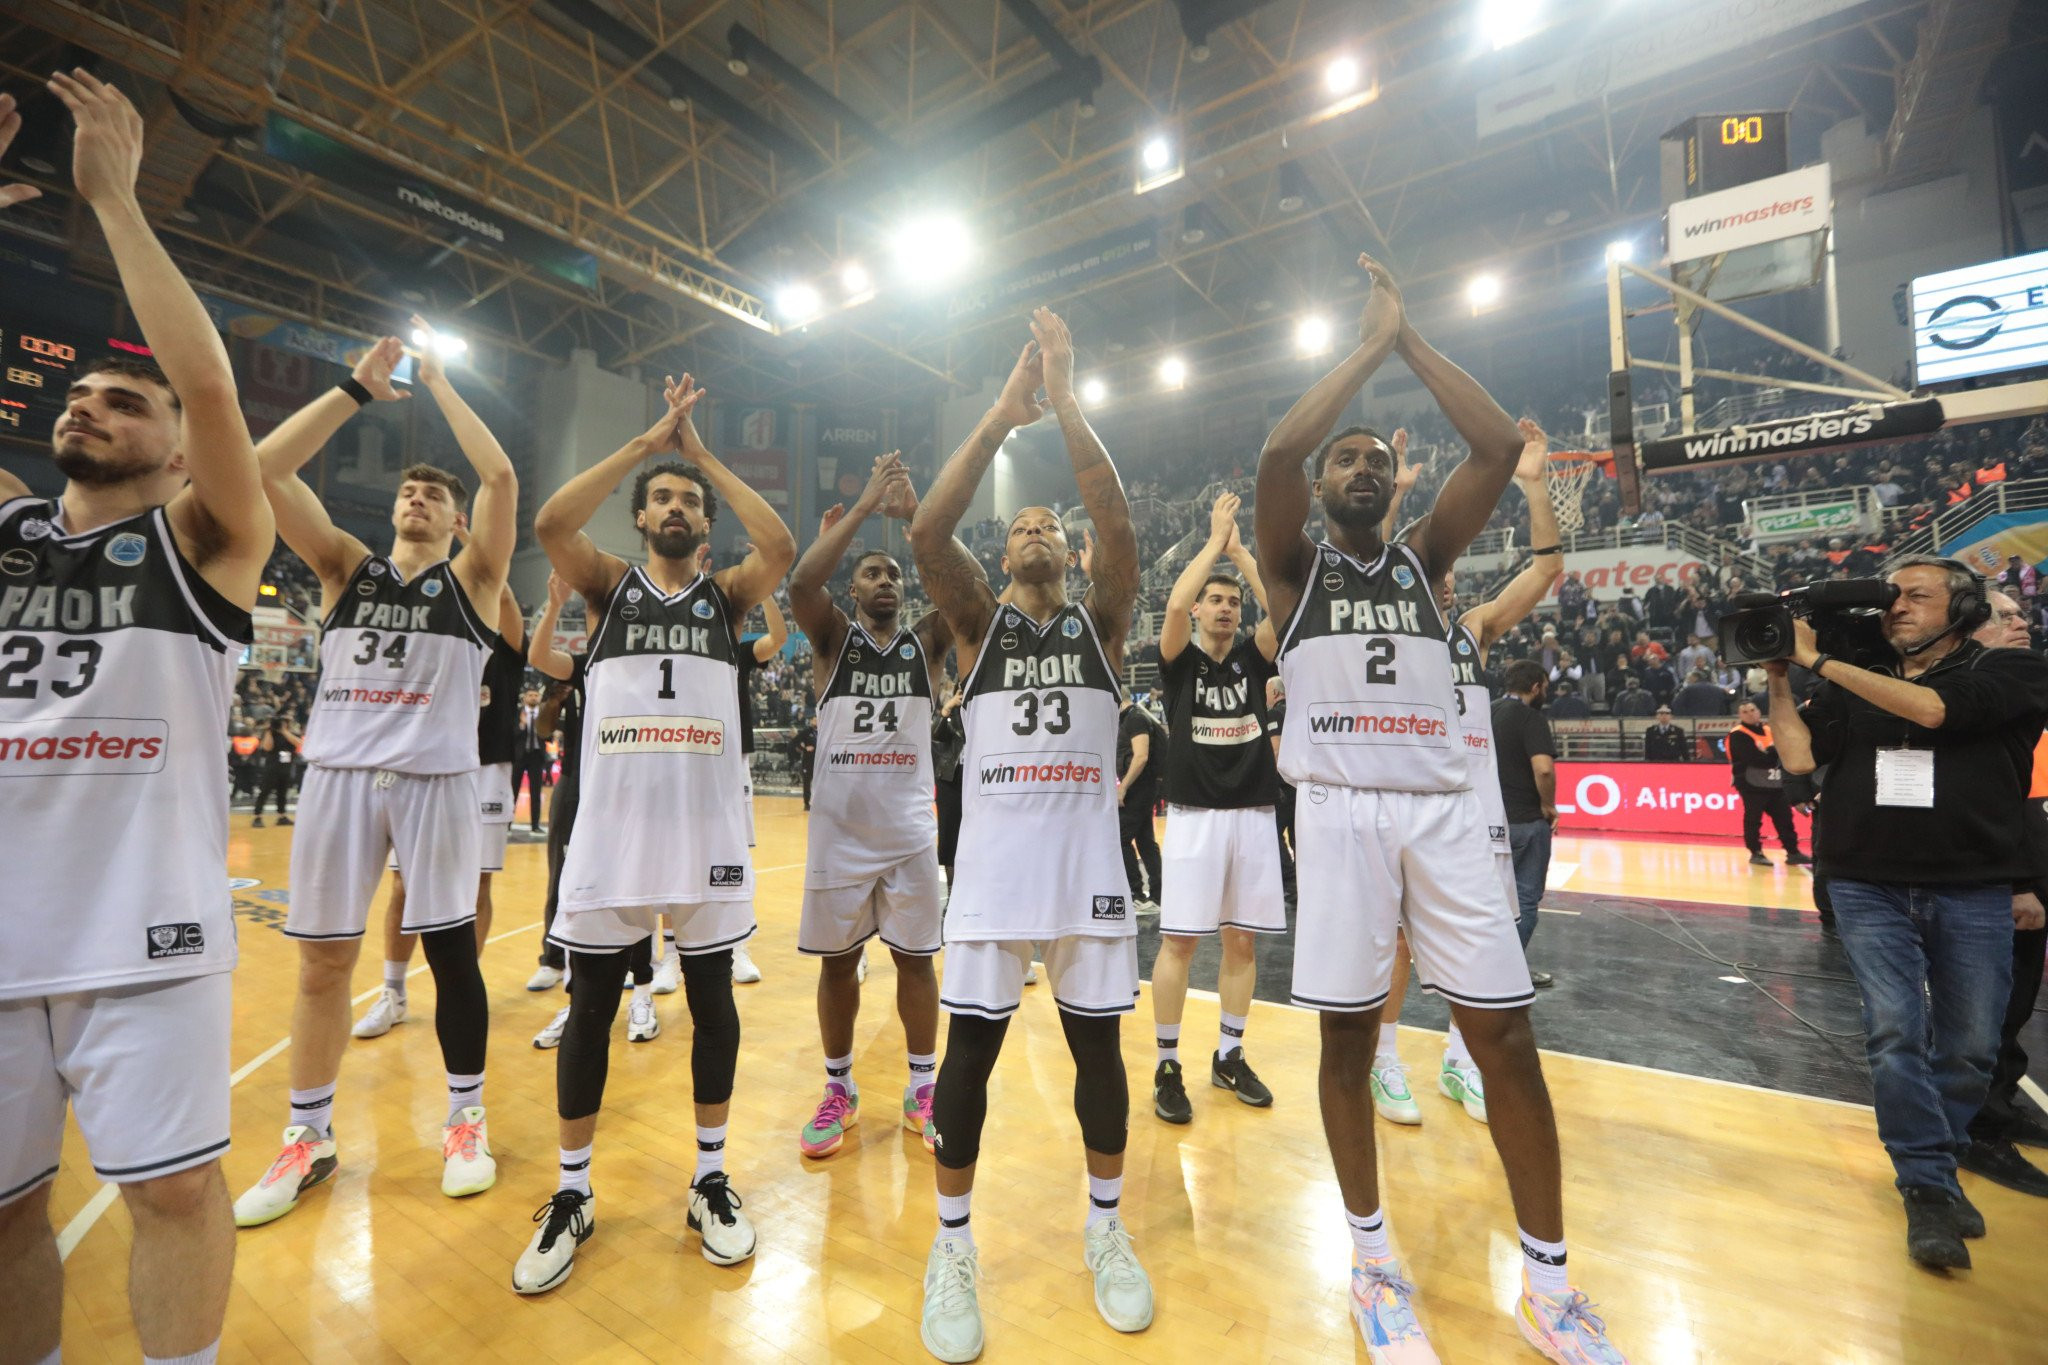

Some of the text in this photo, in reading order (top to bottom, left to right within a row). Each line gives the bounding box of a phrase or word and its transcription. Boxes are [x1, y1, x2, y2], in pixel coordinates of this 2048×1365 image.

[1685, 195, 1814, 239] winmasters
[1684, 412, 1873, 460] winmasters
[0, 584, 138, 630] PAOK
[353, 601, 431, 631] PAOK
[1330, 599, 1421, 632] PAOK
[353, 630, 408, 669] 34
[625, 624, 710, 655] PAOK
[0, 635, 103, 699] 23
[1003, 653, 1085, 688] PAOK
[1365, 637, 1397, 685] 2
[658, 658, 676, 700] 1
[850, 670, 913, 696] PAOK
[853, 700, 898, 733] 24
[1012, 690, 1071, 736] 33
[1310, 711, 1448, 737] winmasters
[601, 724, 722, 746] winmasters
[830, 750, 917, 766] winmasters
[981, 760, 1101, 785] winmasters
